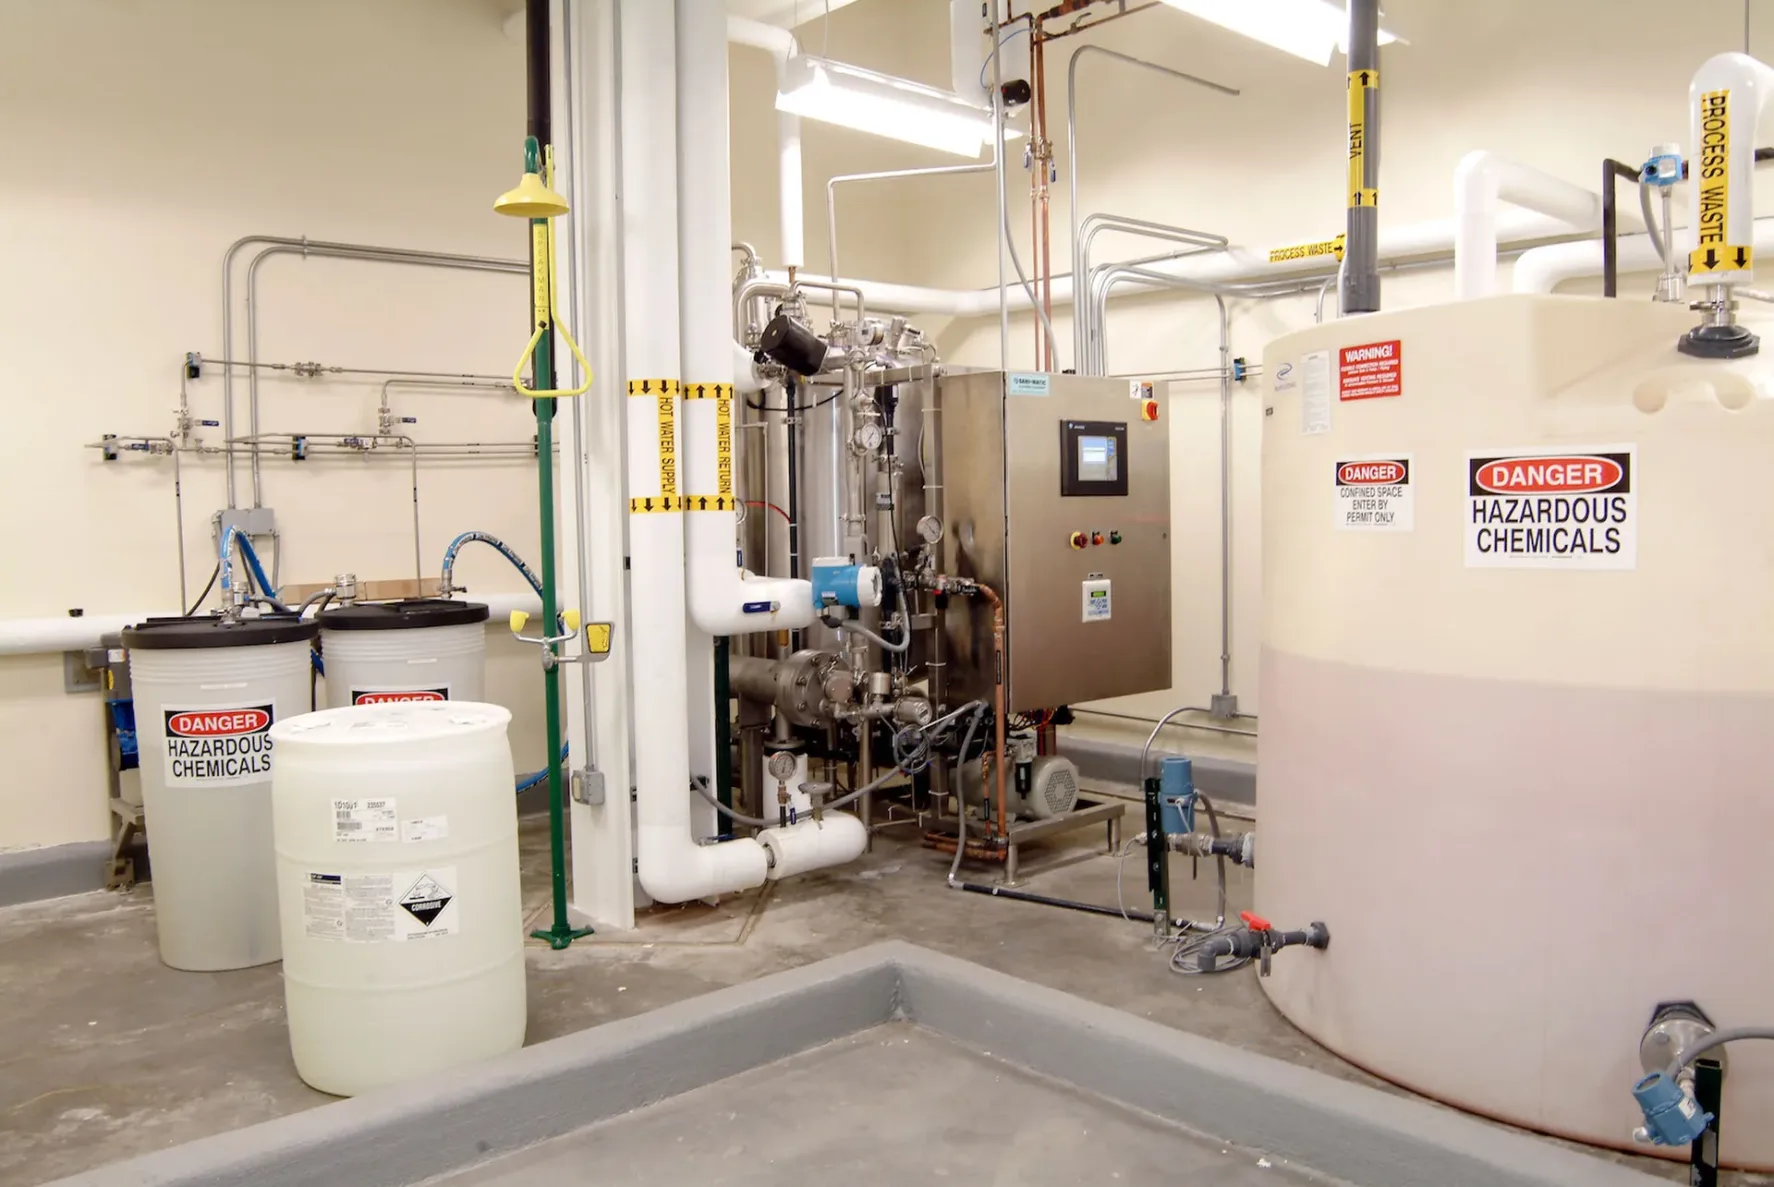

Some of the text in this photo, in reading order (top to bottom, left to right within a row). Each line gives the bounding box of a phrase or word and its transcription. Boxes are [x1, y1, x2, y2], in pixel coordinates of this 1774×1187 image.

[1349, 122, 1362, 159] VENT
[1700, 95, 1726, 244] PROCESS WASTE
[1307, 242, 1333, 256] WASTE
[1345, 345, 1393, 362] WARNING!
[660, 397, 675, 494] HOT WATER SUPPLY
[718, 399, 731, 494] HOT WATER RETURN
[1345, 465, 1397, 480] DANGER
[1492, 463, 1603, 487] DANGER
[1340, 486, 1403, 498] CONFINED SPACE
[1352, 500, 1388, 510] ENTER BY
[1472, 497, 1627, 524] HAZARDOUS
[1347, 512, 1395, 522] PERMIT ONLY
[1477, 527, 1621, 554] CHEMICALS
[179, 713, 258, 731] DANGER
[168, 733, 273, 758] HAZARDOUS
[173, 754, 271, 777] CHEMICALS
[411, 900, 442, 912] CORROSIVE
